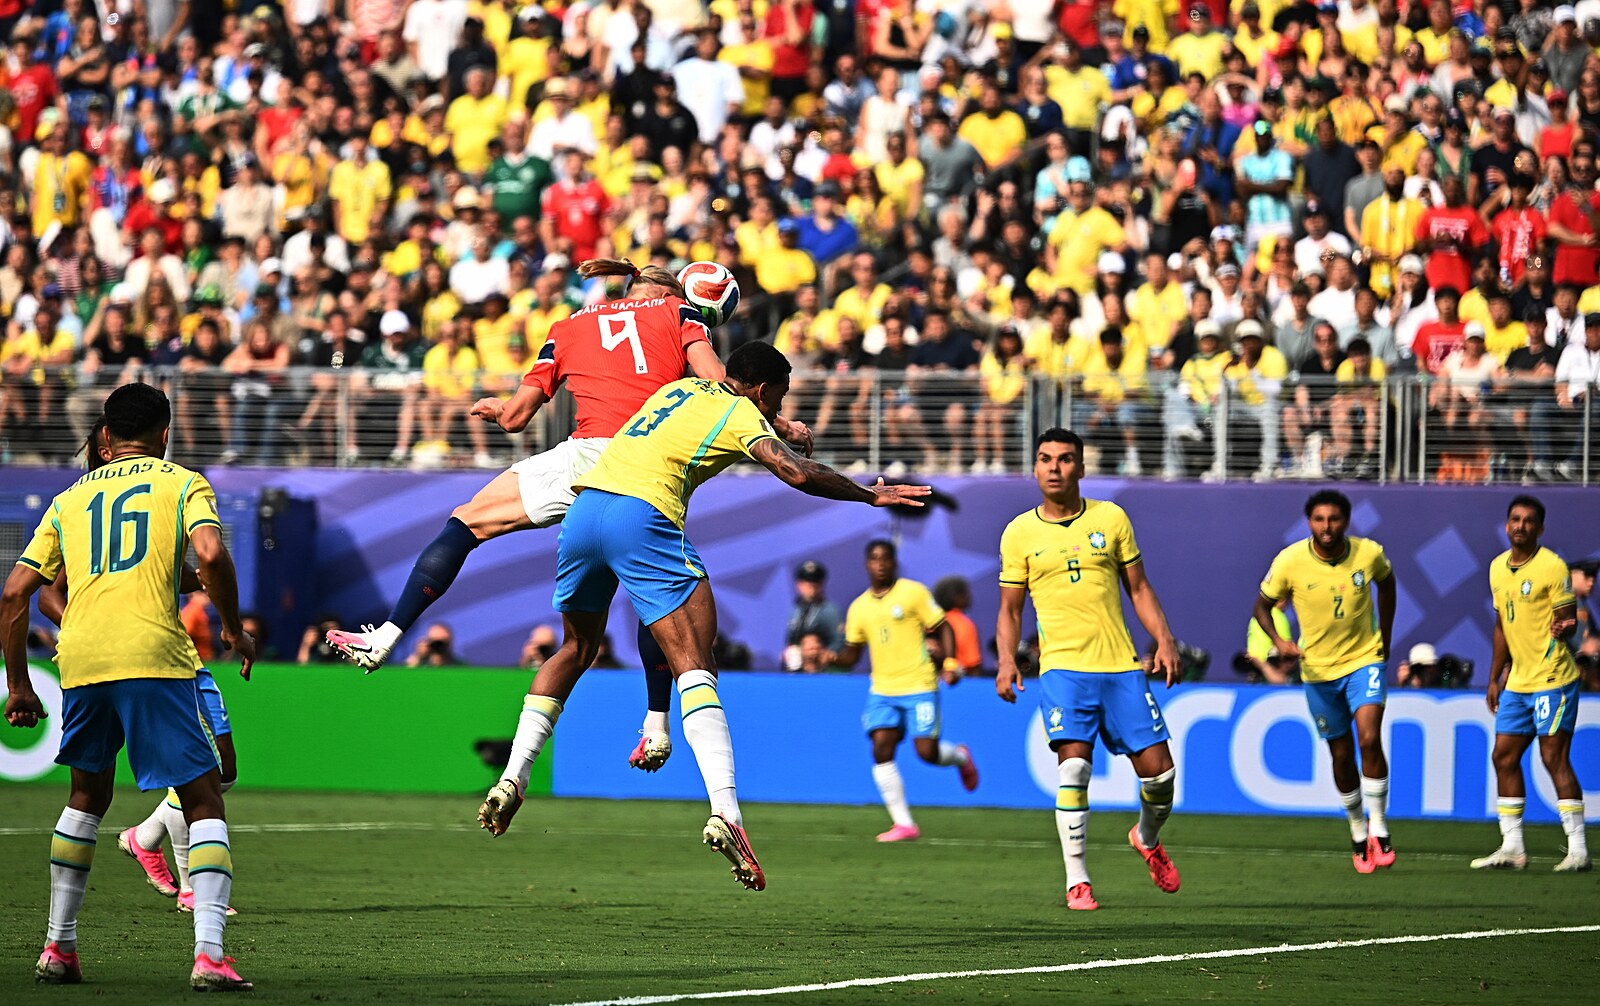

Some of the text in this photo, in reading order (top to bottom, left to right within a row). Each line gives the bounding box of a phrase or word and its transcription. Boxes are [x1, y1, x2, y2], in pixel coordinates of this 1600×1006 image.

[598, 311, 648, 374] 9
[624, 388, 694, 437] 3
[160, 463, 176, 475] S.
[86, 484, 152, 575] 16
[1067, 559, 1081, 583] 5
[1333, 595, 1344, 619] 2
[1368, 666, 1381, 690] 2
[1144, 692, 1160, 720] 5
[1535, 695, 1550, 720] 13
